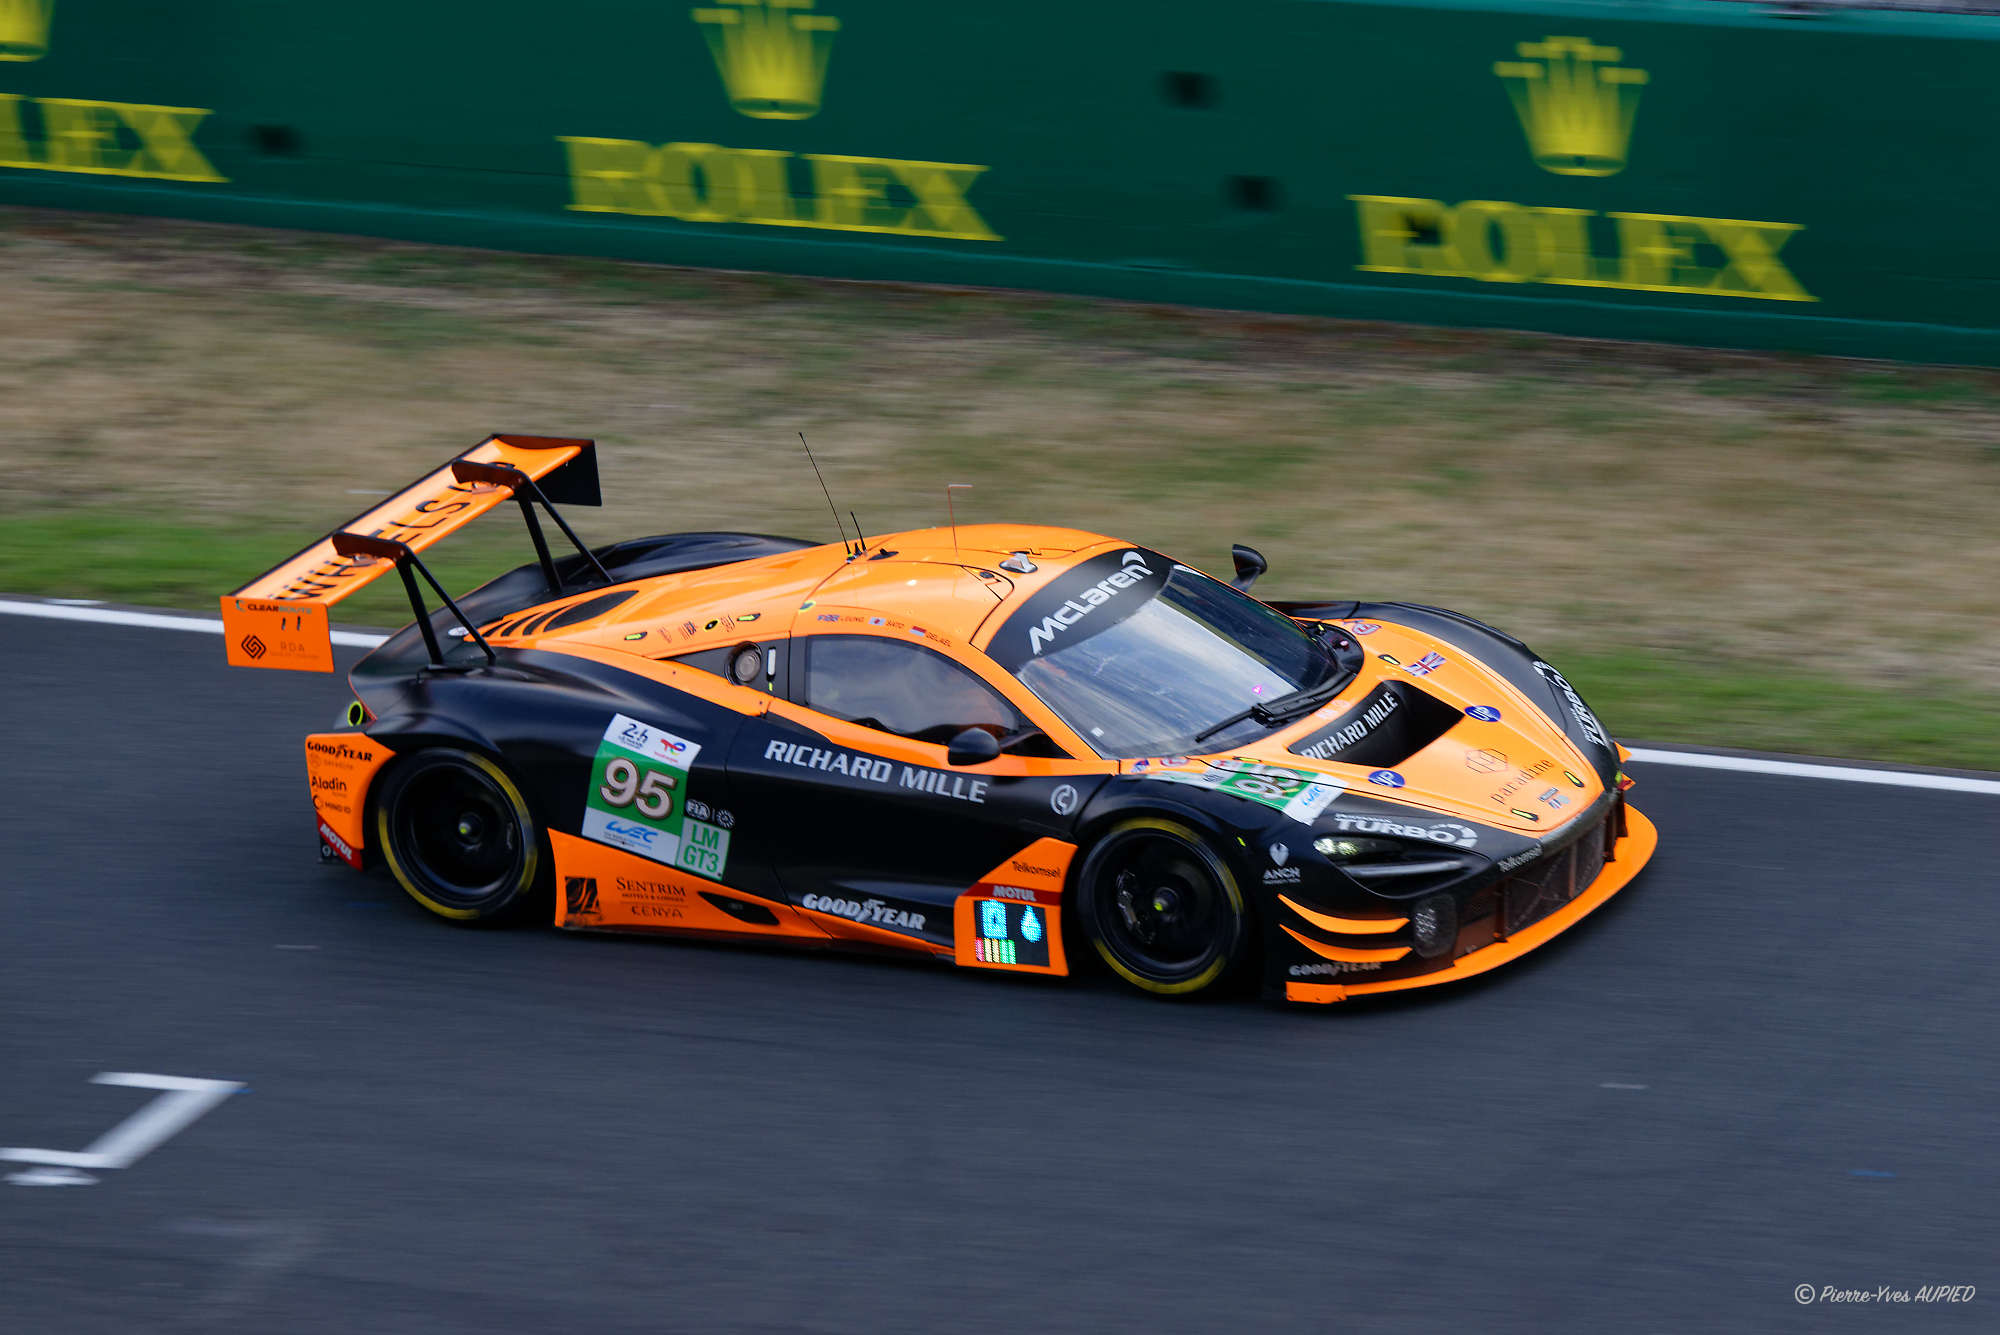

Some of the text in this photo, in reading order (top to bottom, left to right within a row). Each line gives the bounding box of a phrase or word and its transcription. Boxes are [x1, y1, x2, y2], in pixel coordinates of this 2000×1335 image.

[555, 135, 1005, 242] ROLEX
[1346, 194, 1820, 302] ROLEX
[268, 500, 471, 600] WHELS
[1029, 562, 1153, 655] McLaren
[1363, 691, 1399, 730] MILLE
[307, 741, 373, 762] GOODYEAR
[311, 776, 347, 792] Aladin
[600, 757, 677, 821] 95
[764, 740, 988, 804] RICHARD MILLE
[320, 823, 352, 860] MOTUL
[691, 824, 720, 850] LM
[1335, 817, 1457, 844] TURBO
[683, 845, 719, 873] GT3
[803, 893, 927, 931] GOODYEAR
[993, 885, 1037, 902] MOTUL
